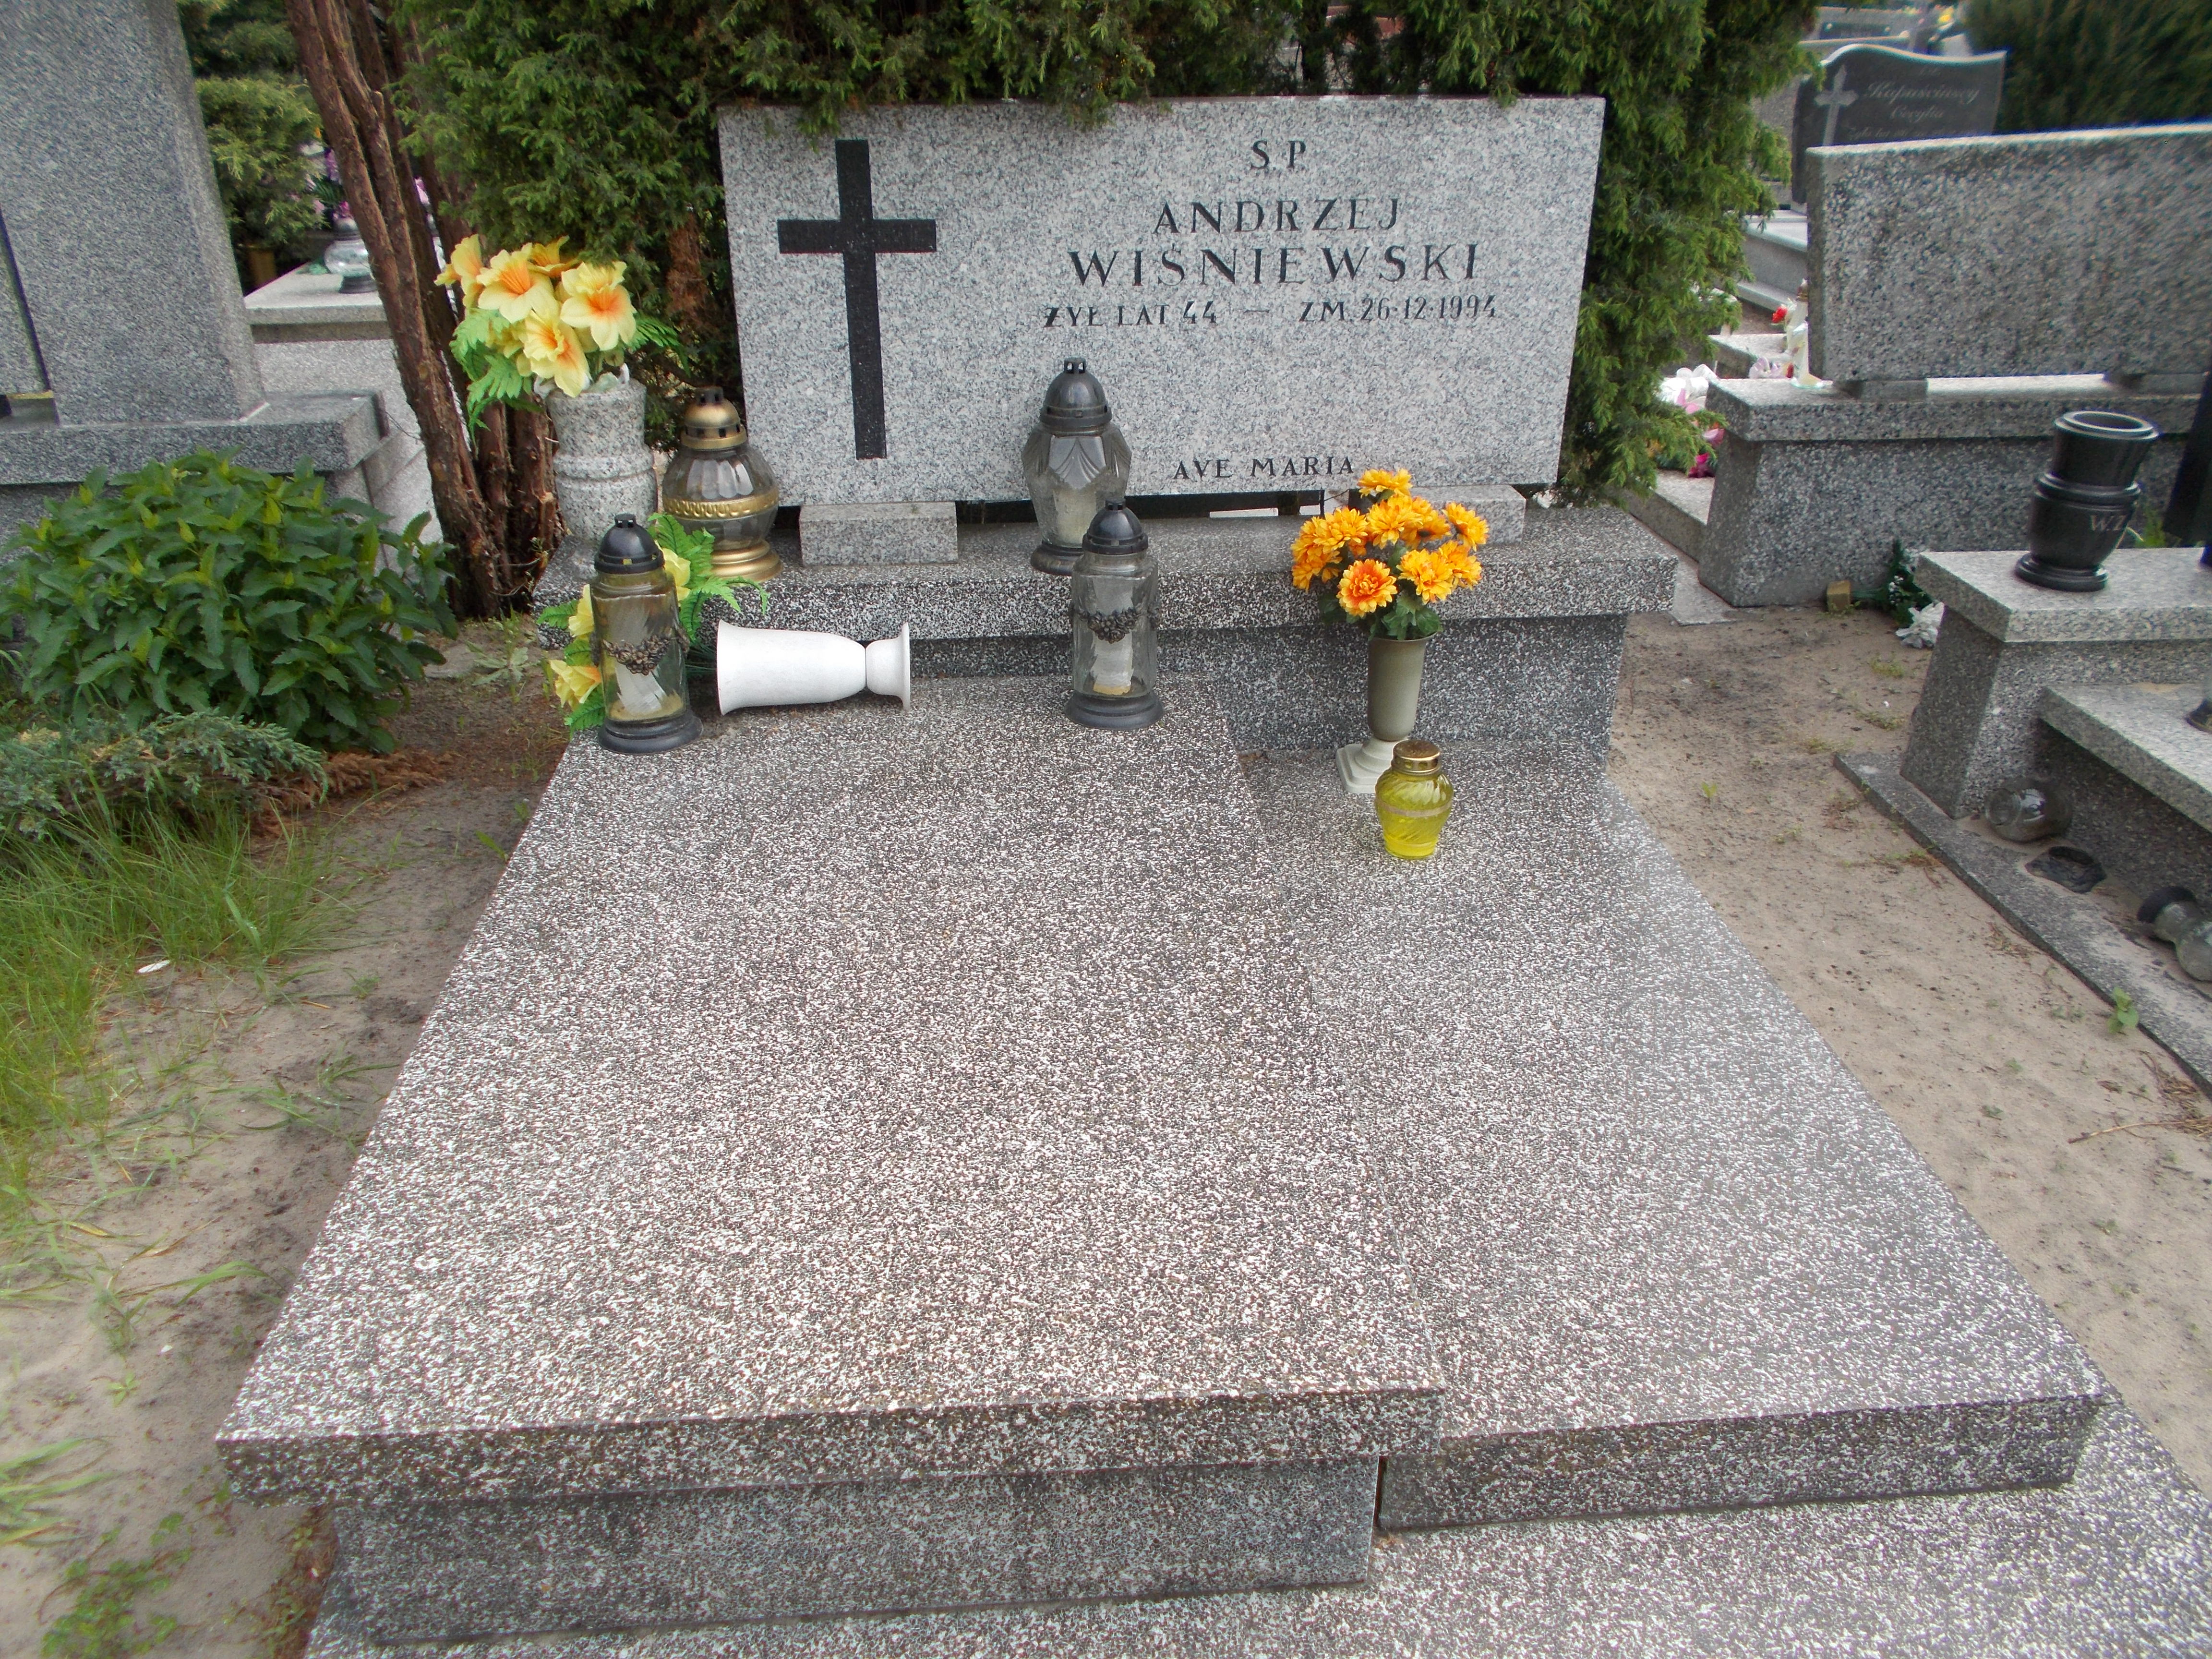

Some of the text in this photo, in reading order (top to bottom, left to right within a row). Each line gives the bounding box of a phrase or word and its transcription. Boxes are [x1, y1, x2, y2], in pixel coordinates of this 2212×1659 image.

[1153, 198, 1398, 233] ANDRZEJ
[1067, 243, 1478, 287] WIŚNIEWSKI
[1118, 304, 1170, 326] LAT
[1183, 301, 1217, 325] 44
[1173, 456, 1354, 480] AVE MARIA
